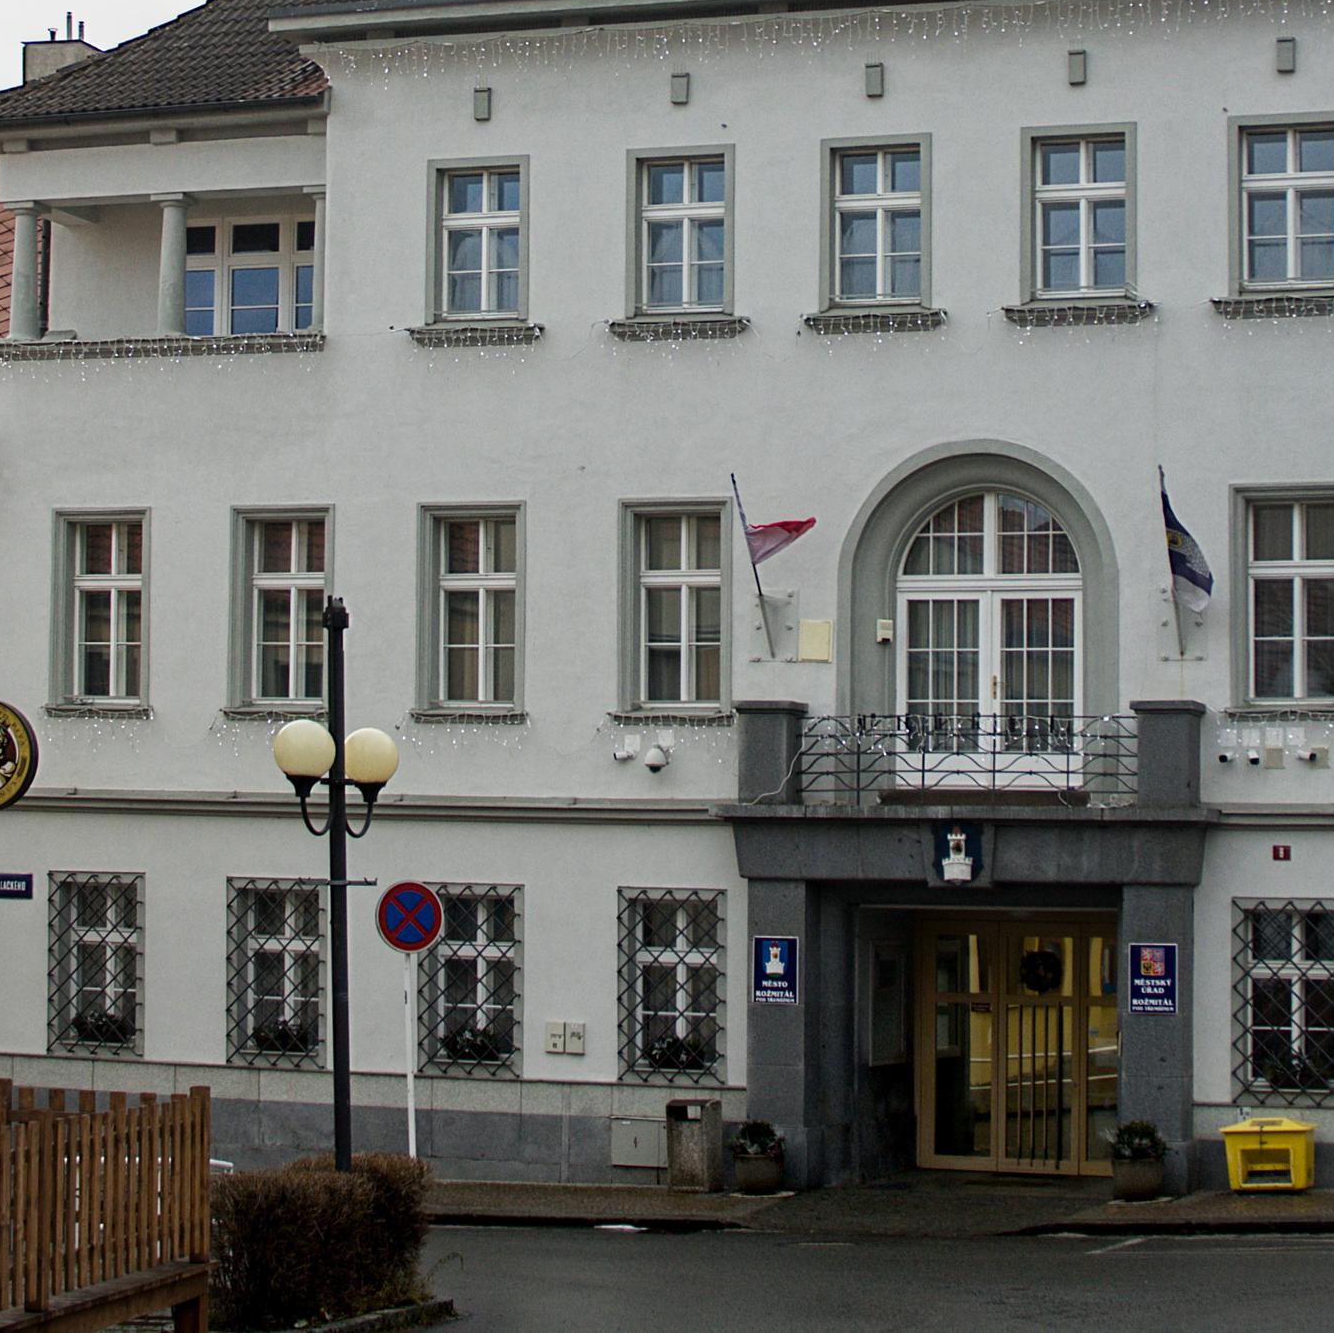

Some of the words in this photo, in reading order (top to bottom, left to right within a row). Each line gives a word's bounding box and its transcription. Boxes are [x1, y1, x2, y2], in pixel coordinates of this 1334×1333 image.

[762, 979, 788, 987] MĚSTO
[1134, 977, 1172, 986] MĚSTSKÝ
[755, 989, 795, 997] ROŽMITÁL
[1141, 986, 1165, 994] ÚŘAD
[1132, 998, 1174, 1006] ROŽMITÁL
